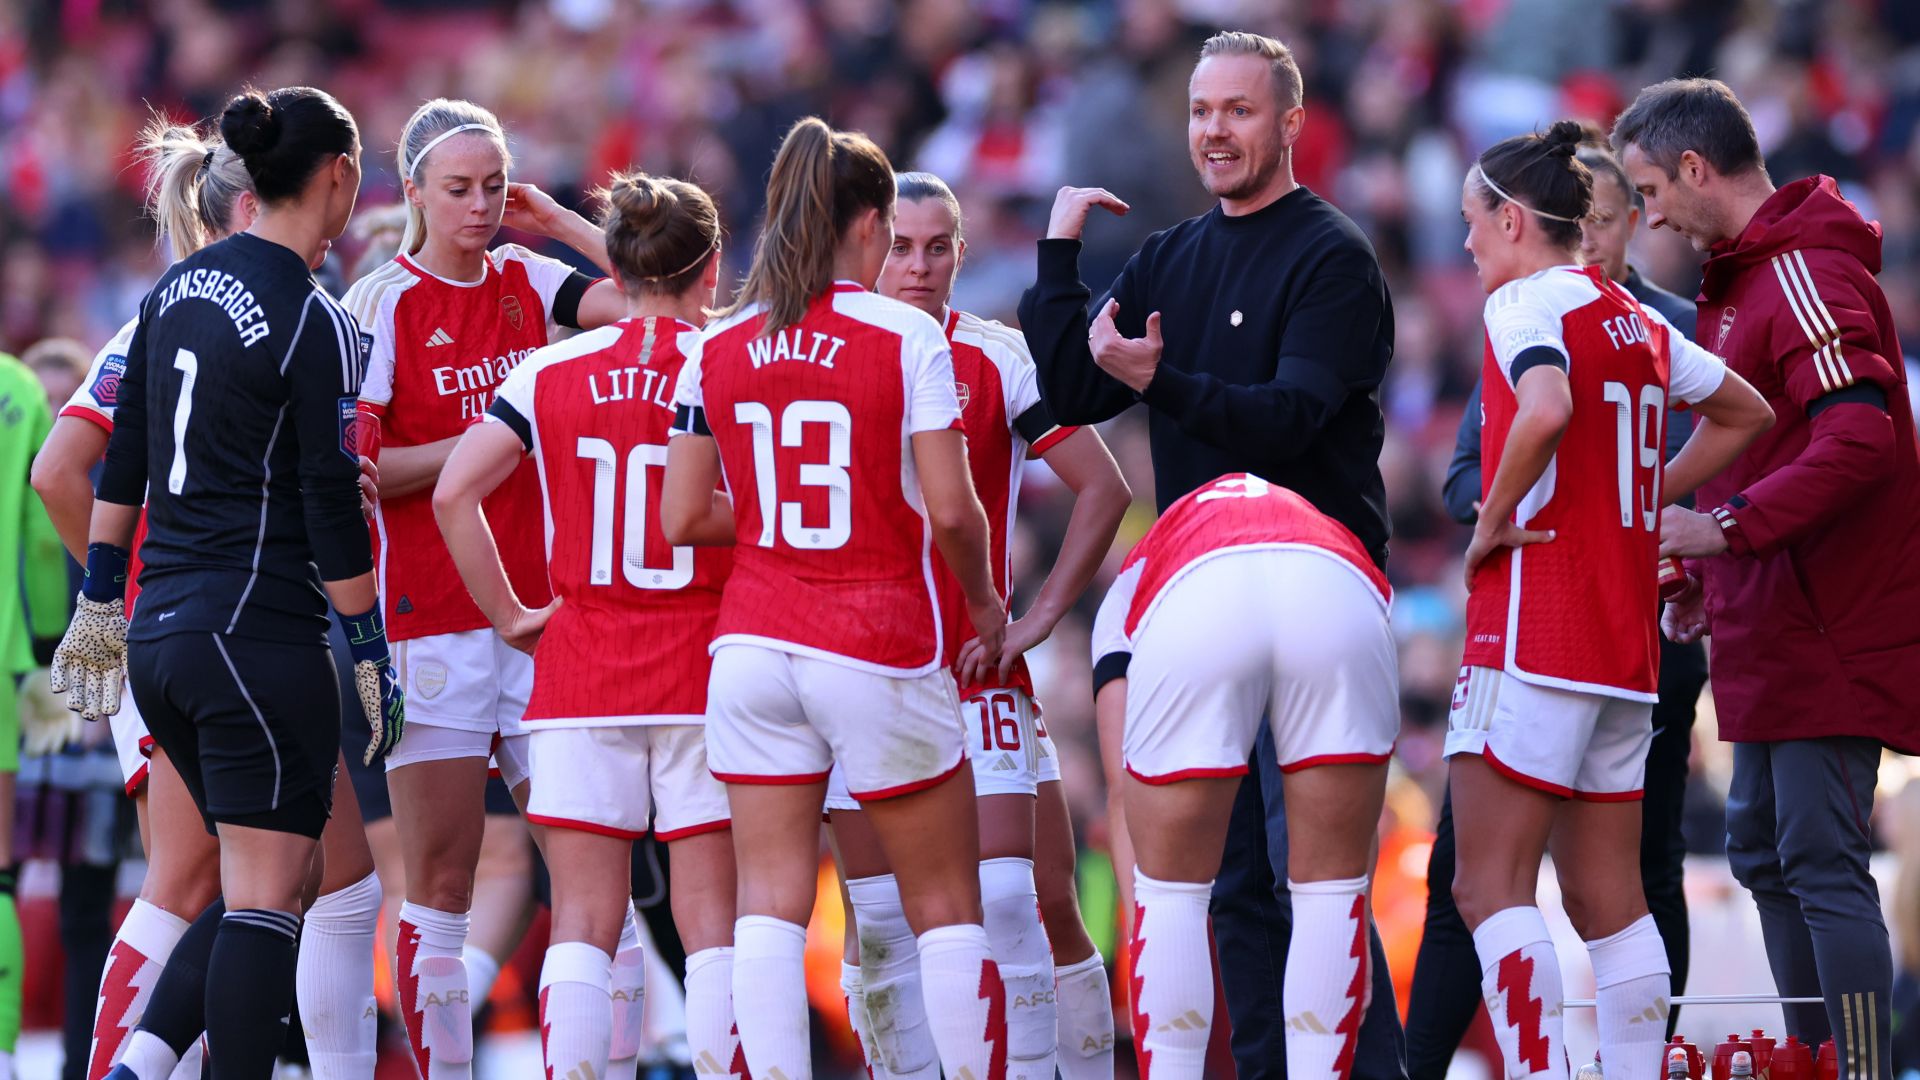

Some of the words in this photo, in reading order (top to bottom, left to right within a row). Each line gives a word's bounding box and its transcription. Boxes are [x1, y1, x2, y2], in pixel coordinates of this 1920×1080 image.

[159, 268, 270, 348] ZINSBERGER
[588, 367, 677, 410] LITTL
[746, 328, 846, 370] WALTI
[168, 347, 198, 496] 1
[1603, 381, 1665, 532] 19
[576, 436, 694, 590] 10
[734, 400, 852, 549] 13
[970, 693, 1021, 751] 16
[1013, 990, 1056, 1009] AFC
